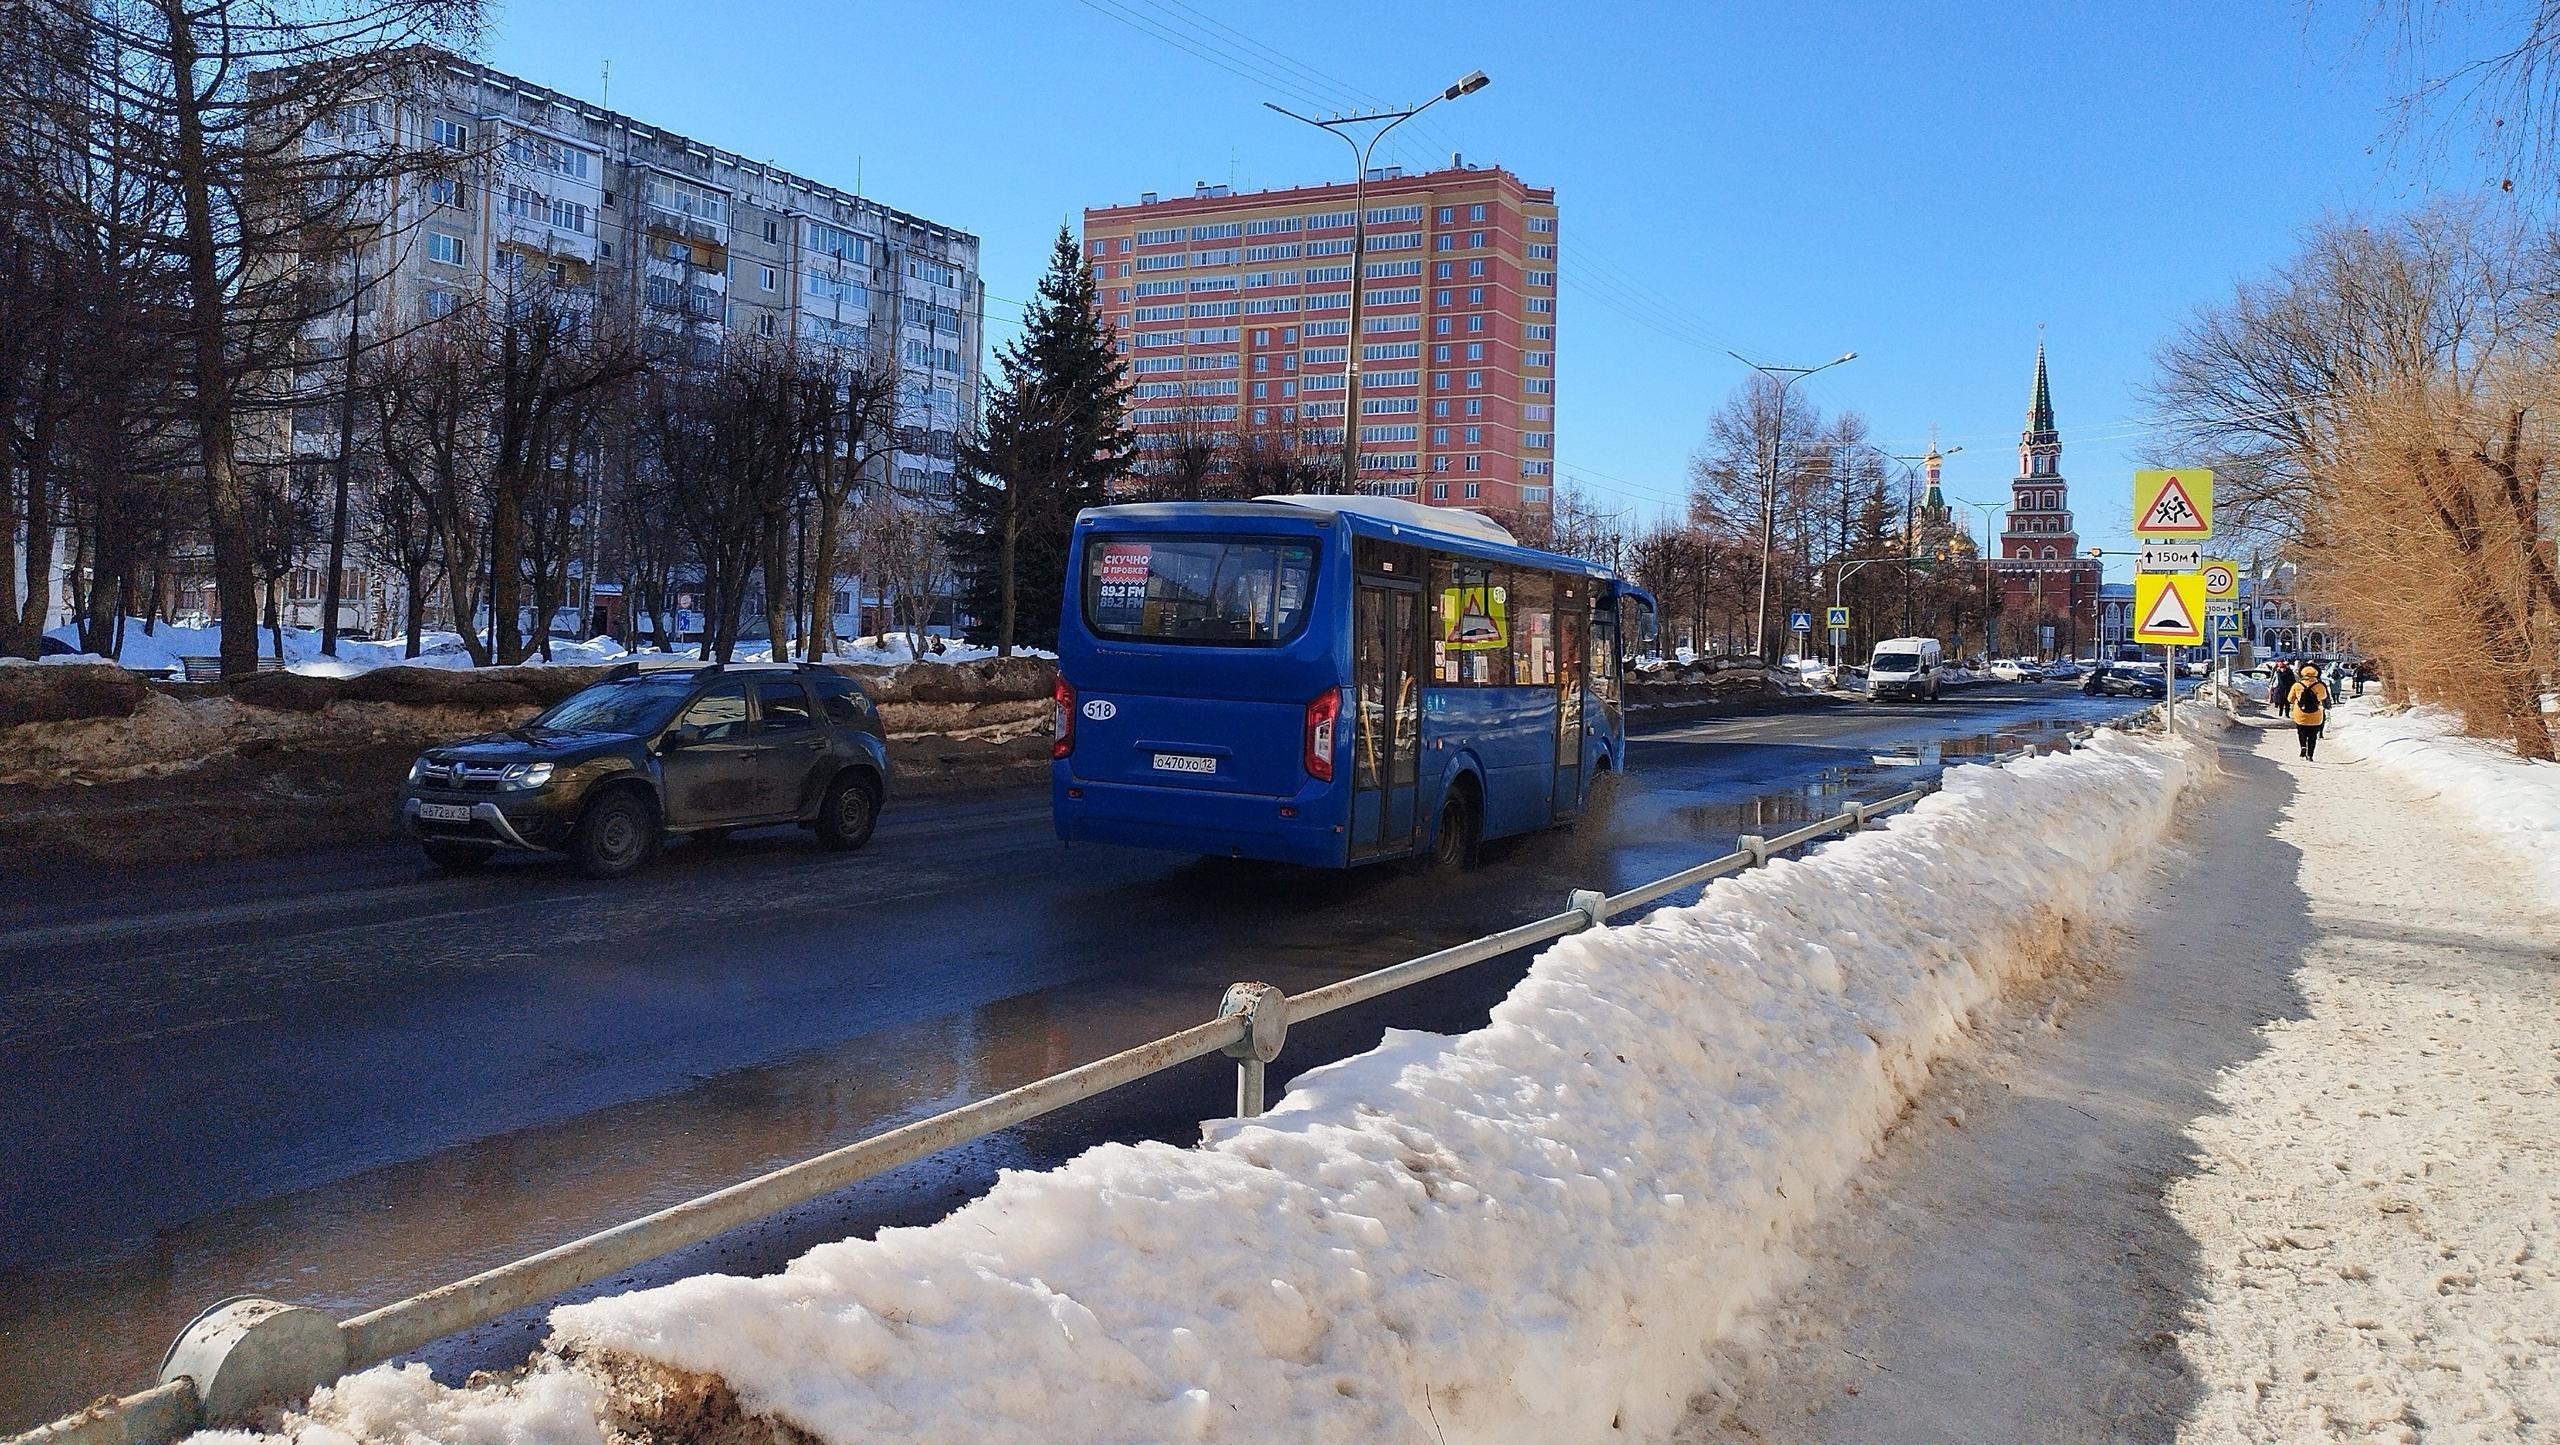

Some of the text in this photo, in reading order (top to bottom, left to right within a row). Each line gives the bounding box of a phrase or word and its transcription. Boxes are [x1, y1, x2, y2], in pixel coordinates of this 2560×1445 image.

[1104, 554, 1149, 565] СКУЧНО
[2157, 552, 2189, 563] 150м
[1103, 566, 1148, 575] В ПРОБКЕ?
[2207, 574, 2227, 587] 20
[1100, 585, 1146, 598] 89.2 FM
[1099, 596, 1144, 609] 89.2 FM
[1087, 703, 1112, 717] 518
